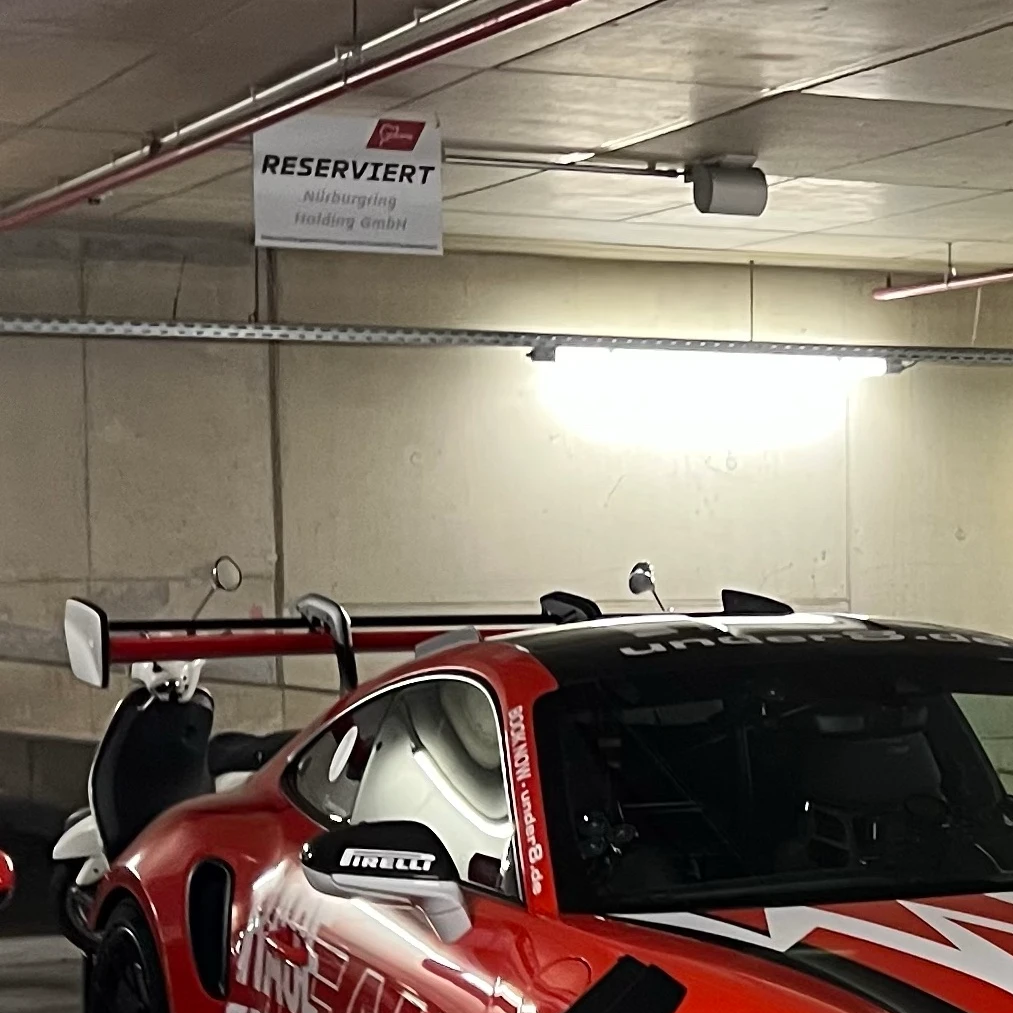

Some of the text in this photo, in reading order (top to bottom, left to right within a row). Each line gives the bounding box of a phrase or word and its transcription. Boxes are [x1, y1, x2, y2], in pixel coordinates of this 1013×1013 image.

[262, 154, 435, 185] RESERVIERT
[302, 188, 397, 211] Nürburgring
[294, 211, 407, 231] Holding GmbH
[508, 705, 544, 896] BOOK NOW under8.de
[340, 848, 436, 871] PIRELLI
